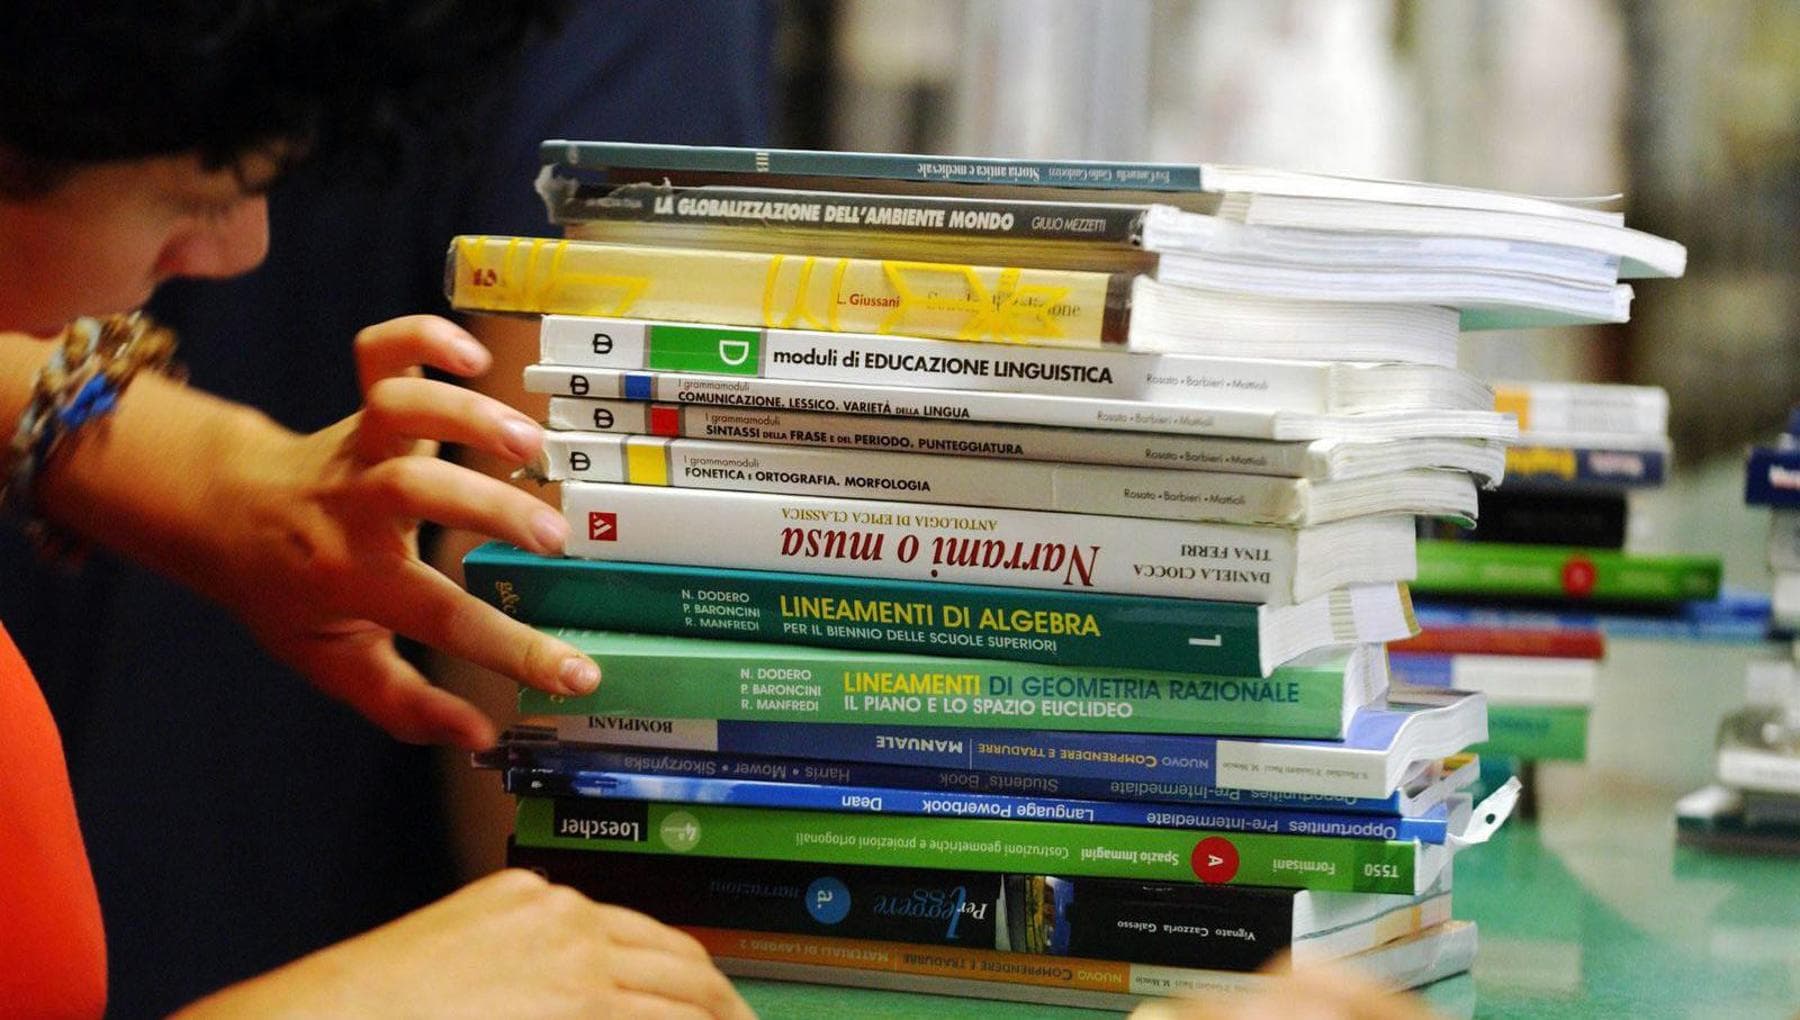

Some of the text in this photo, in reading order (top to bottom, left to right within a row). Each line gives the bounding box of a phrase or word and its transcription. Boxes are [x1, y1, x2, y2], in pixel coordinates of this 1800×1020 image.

[917, 164, 1040, 180] Storia antica e medievale
[654, 197, 674, 215] LA
[678, 198, 820, 222] GLOBALIZZAZIONE
[824, 204, 944, 228] DELL'AMBIENTE
[949, 211, 1014, 231] MONDO
[1031, 216, 1106, 232] GIULIO MEZZETTI
[849, 294, 901, 308] Giussani
[774, 349, 1113, 384] moduli di EDUCAZIONE LINGUISTICA
[684, 380, 750, 392] grammamoduli
[1147, 374, 1269, 390] Rosato Barbieri Mattioli
[844, 400, 892, 415] VARIETÀ
[896, 406, 919, 416] DELLA
[923, 405, 970, 419] LINGUA
[1098, 411, 1127, 422] Rosato
[1135, 413, 1172, 424] Barbieri
[711, 414, 780, 426] grammamoduli
[706, 425, 760, 439] SINTASSI
[763, 431, 787, 440] DELLA
[790, 430, 827, 442] FRASE
[837, 436, 852, 444] DEL
[918, 438, 1024, 455] PUNTEGGIATURA
[690, 456, 760, 468] grammamoduli
[1145, 449, 1178, 461] Rosato
[1185, 451, 1223, 463] Barbieri
[685, 467, 744, 481] FONETICA
[844, 476, 931, 492] MORFOLOGIA
[1124, 488, 1247, 505] Rosato Barbieri Mattioli
[781, 507, 998, 531] ANTOLOGIA DI EPICA CLASSICA
[780, 526, 1100, 587] Narrami o musa
[1181, 543, 1272, 561] TINA FERRI
[1133, 564, 1270, 584] DANIELA CIOCCA
[681, 589, 750, 603] N. DODERO
[683, 604, 760, 618] P. BARONCINI
[780, 595, 1101, 637] LINEAMENTI DI ALGEBRA
[685, 617, 760, 631] R. MANFREDI
[783, 623, 1057, 652] PER IL BIENNIO DELLE SCUOLE SUPERIORI
[741, 668, 812, 681] N. DODERO
[740, 683, 821, 697] P. BARONCINI
[843, 672, 1299, 703] LINEAMENTI DI GEOMETRIA RAZIONALE
[741, 699, 819, 712] R. MANFREDI
[844, 695, 1133, 718] IL PIANO E LO SPAZIO EUCLIDEO
[588, 716, 673, 734] BOMPIANI
[876, 735, 963, 754] MANUALE
[978, 743, 1045, 757] TRADURRE
[1049, 748, 1056, 758] E
[734, 762, 787, 778] Mower
[1162, 756, 1209, 769] NUOVO
[805, 765, 850, 781] Harris
[939, 772, 980, 789] Book
[1110, 781, 1240, 801] Pre-Intermediate
[842, 795, 882, 811] Dean
[922, 799, 1094, 822] Language Powerbook
[560, 818, 640, 841] Loescher
[1147, 812, 1396, 839] Opportunities Pre-Intermediate
[796, 831, 1069, 859] Costruzioni geometriche e proiezioni ortogonali
[1081, 845, 1179, 865] Spazio Immagini
[1208, 855, 1223, 867] A
[1273, 858, 1335, 875] Formisani
[1364, 863, 1399, 878] T550
[1117, 919, 1256, 940] Vignato Cazzorla Galesso
[804, 943, 817, 954] DI
[822, 945, 888, 963] MATERIALI
[903, 953, 965, 968] TRADURRE
[1077, 969, 1122, 983] NUOVO
